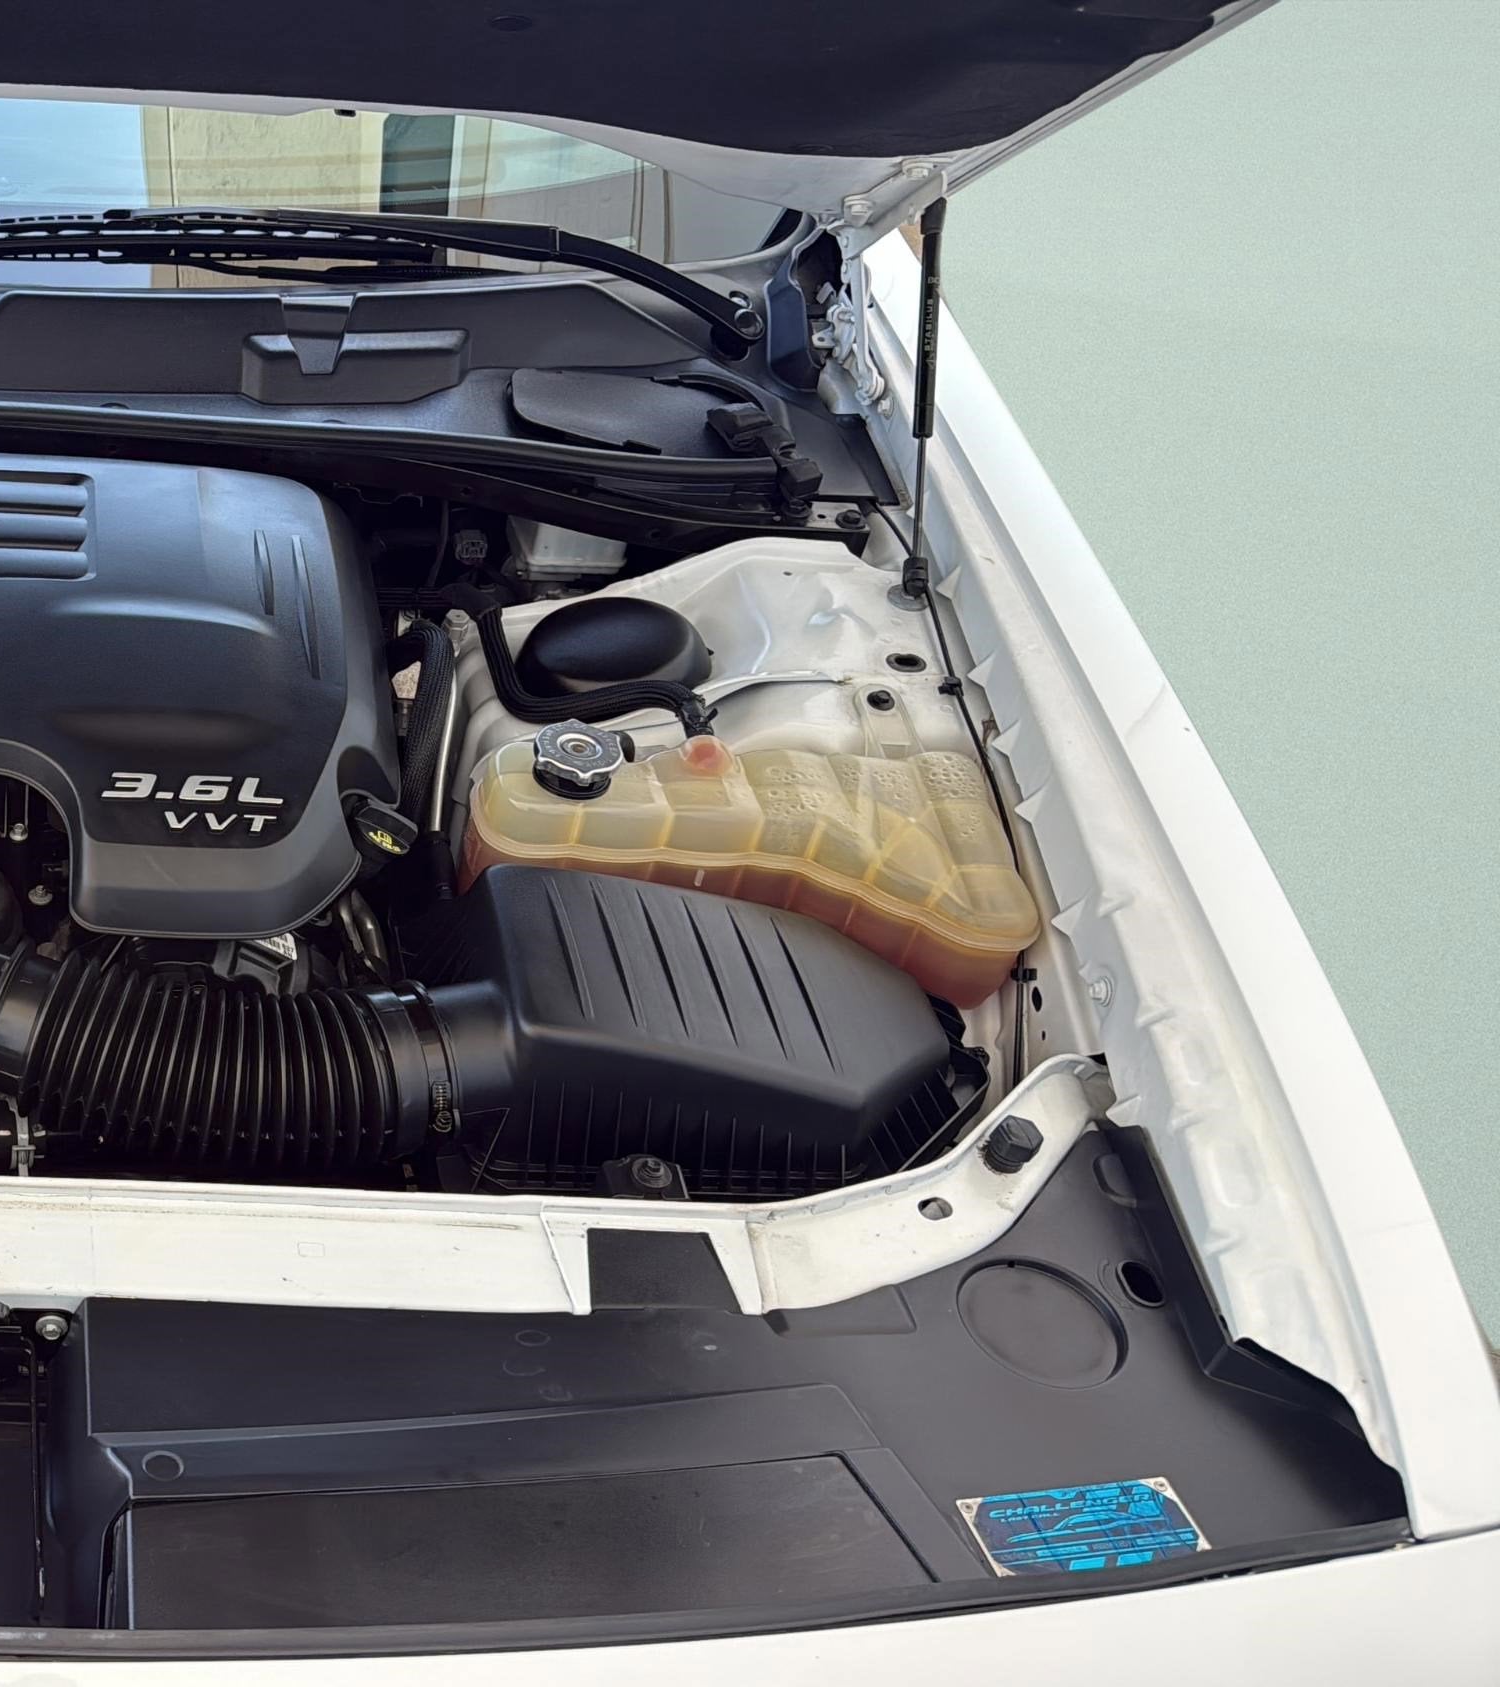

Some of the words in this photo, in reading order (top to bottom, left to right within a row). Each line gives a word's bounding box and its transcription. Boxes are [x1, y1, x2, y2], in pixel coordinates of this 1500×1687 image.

[924, 298, 934, 352] STABILUS
[101, 771, 284, 805] 3.6L
[163, 810, 278, 833] VVT
[989, 1493, 1150, 1518] CHALLENGER
